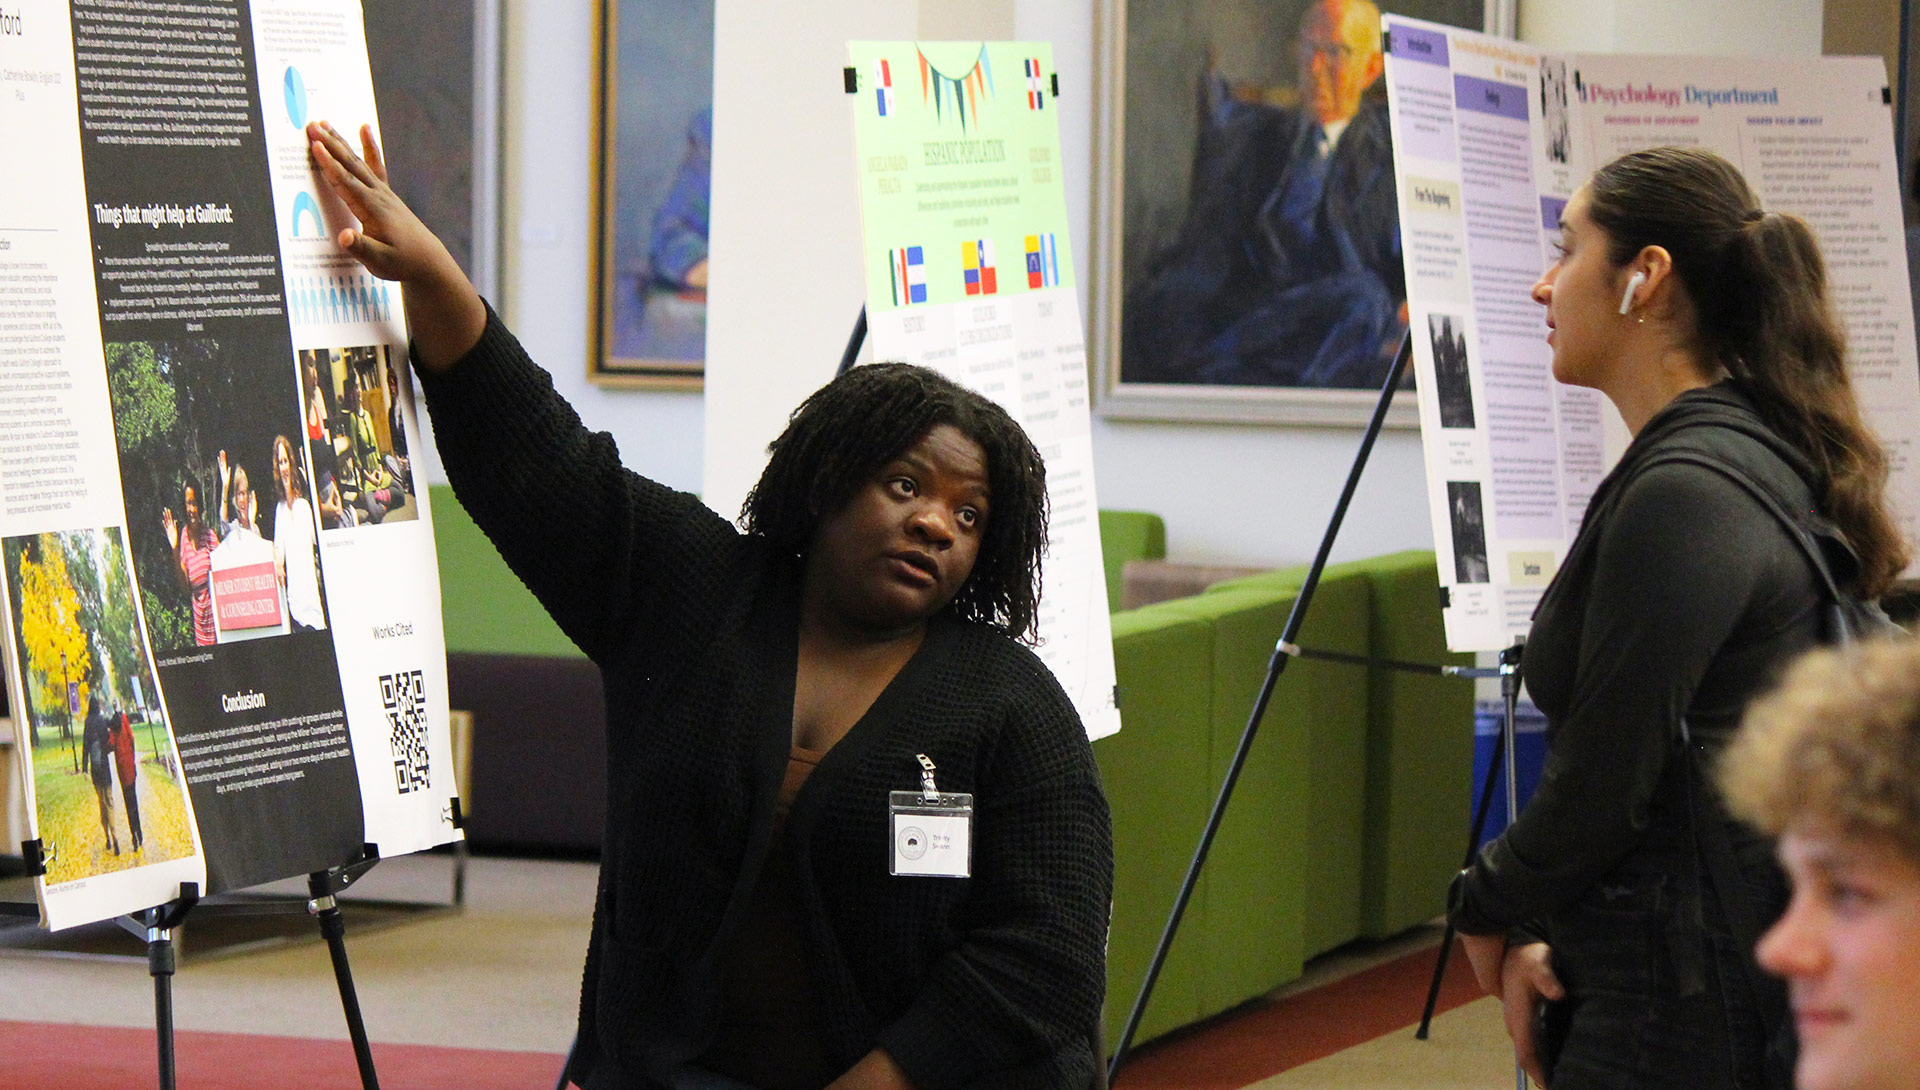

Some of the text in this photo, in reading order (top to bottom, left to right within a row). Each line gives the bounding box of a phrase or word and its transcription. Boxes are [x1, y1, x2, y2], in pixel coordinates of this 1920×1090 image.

[1590, 83, 1778, 108] Psychology Department
[923, 138, 1005, 167] HISPANIC POPULATION
[94, 203, 234, 229] Things that might help at Guilford:
[215, 574, 275, 596] MILNER STUDENT HEALTH
[226, 600, 255, 618] COUNSELING
[255, 598, 275, 615] CENTER
[372, 620, 413, 639] Works Cited
[221, 689, 267, 713] Conclusion
